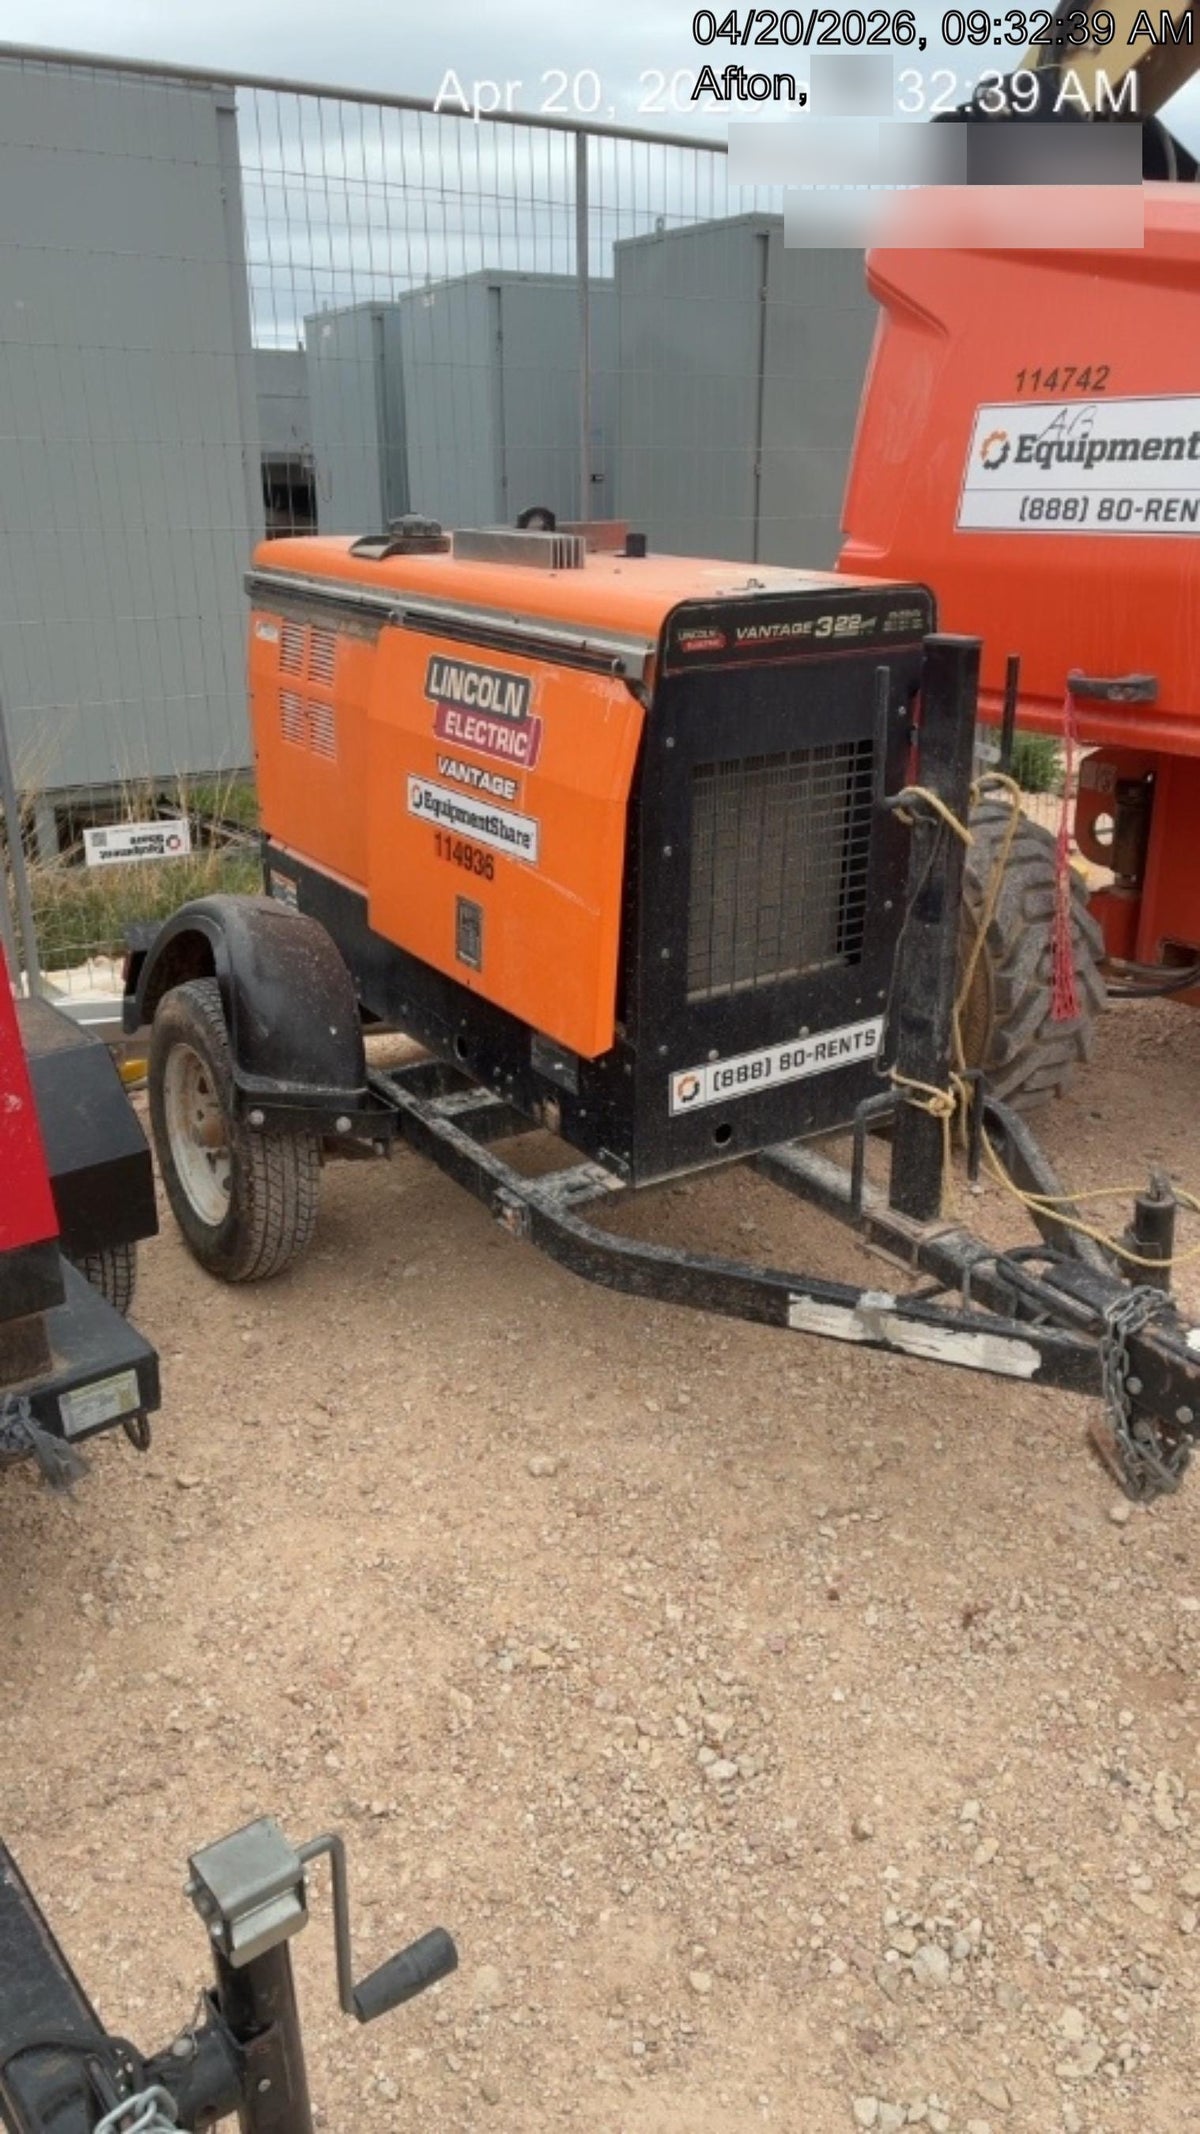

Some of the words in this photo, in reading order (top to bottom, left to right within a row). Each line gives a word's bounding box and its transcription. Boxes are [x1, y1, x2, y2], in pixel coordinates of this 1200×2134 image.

[1016, 365, 1110, 392] 114742
[1013, 430, 1200, 470] Equipment
[1019, 496, 1089, 522] (888)
[1097, 497, 1200, 522] 80-REN
[736, 621, 814, 640] VANTAGE
[815, 614, 862, 638] 322
[429, 663, 525, 718] LINCOLN
[444, 710, 528, 758] ELECTRIC
[437, 755, 517, 800] VANTAGE
[423, 791, 531, 849] EquipmentShare
[434, 831, 495, 881] 114936
[713, 1058, 772, 1091] (888)
[779, 1029, 876, 1071] 80-RENTS
